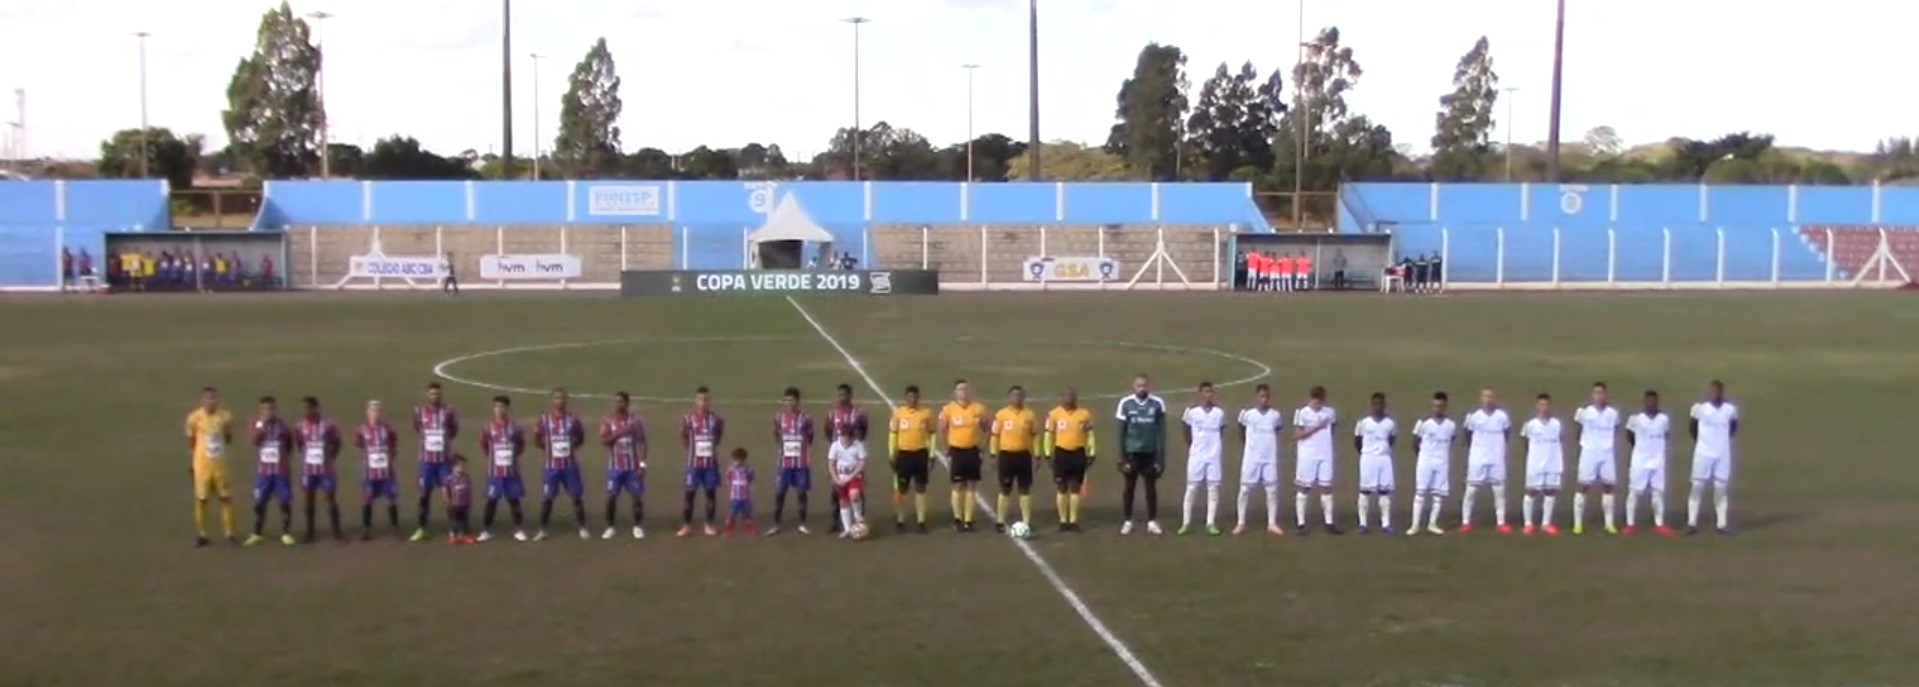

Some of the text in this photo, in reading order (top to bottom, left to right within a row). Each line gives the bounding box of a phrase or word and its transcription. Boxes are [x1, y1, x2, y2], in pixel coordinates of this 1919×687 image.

[696, 274, 746, 290] COPA
[750, 274, 812, 290] VERDE
[816, 273, 861, 290] 2019
